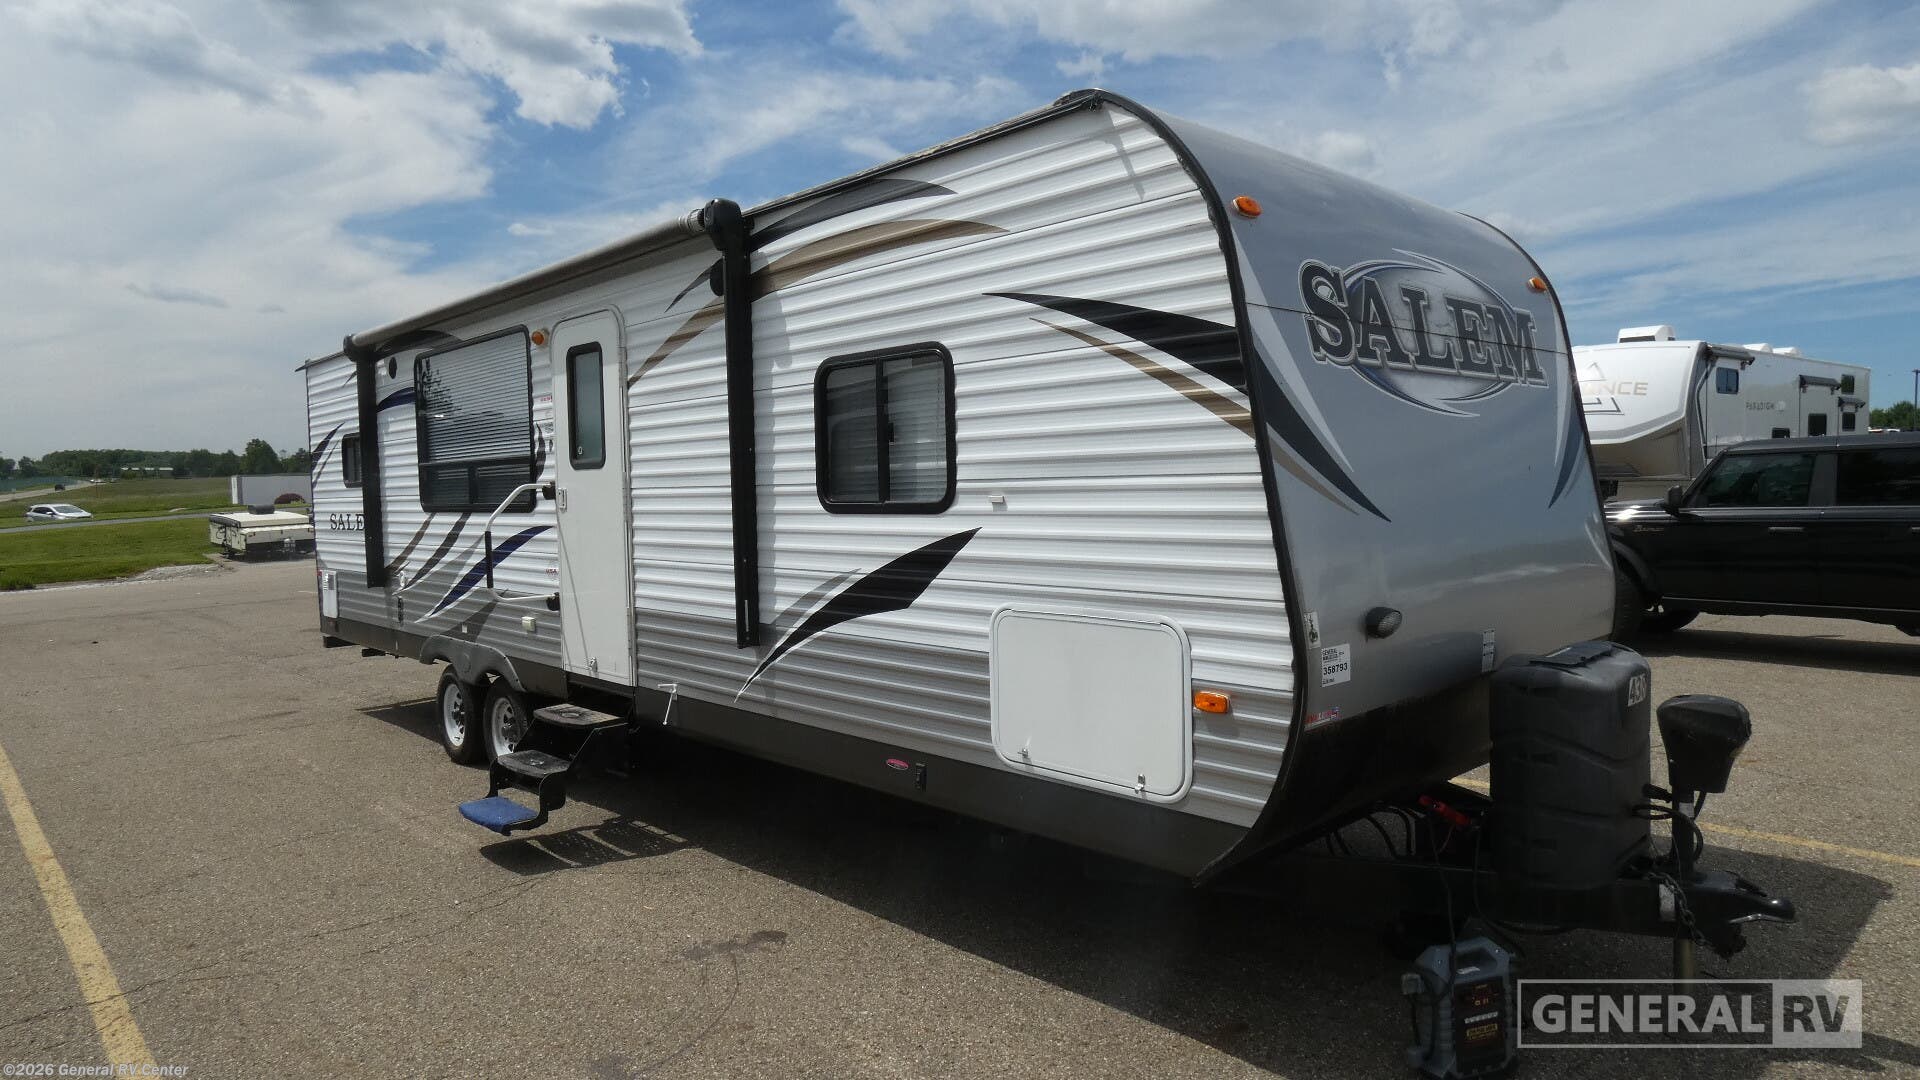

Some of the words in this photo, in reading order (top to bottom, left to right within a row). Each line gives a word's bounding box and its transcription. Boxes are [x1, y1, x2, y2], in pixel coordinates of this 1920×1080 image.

[1298, 258, 1549, 388] SALEM
[330, 513, 365, 530] SALE
[1323, 662, 1348, 675] 358793
